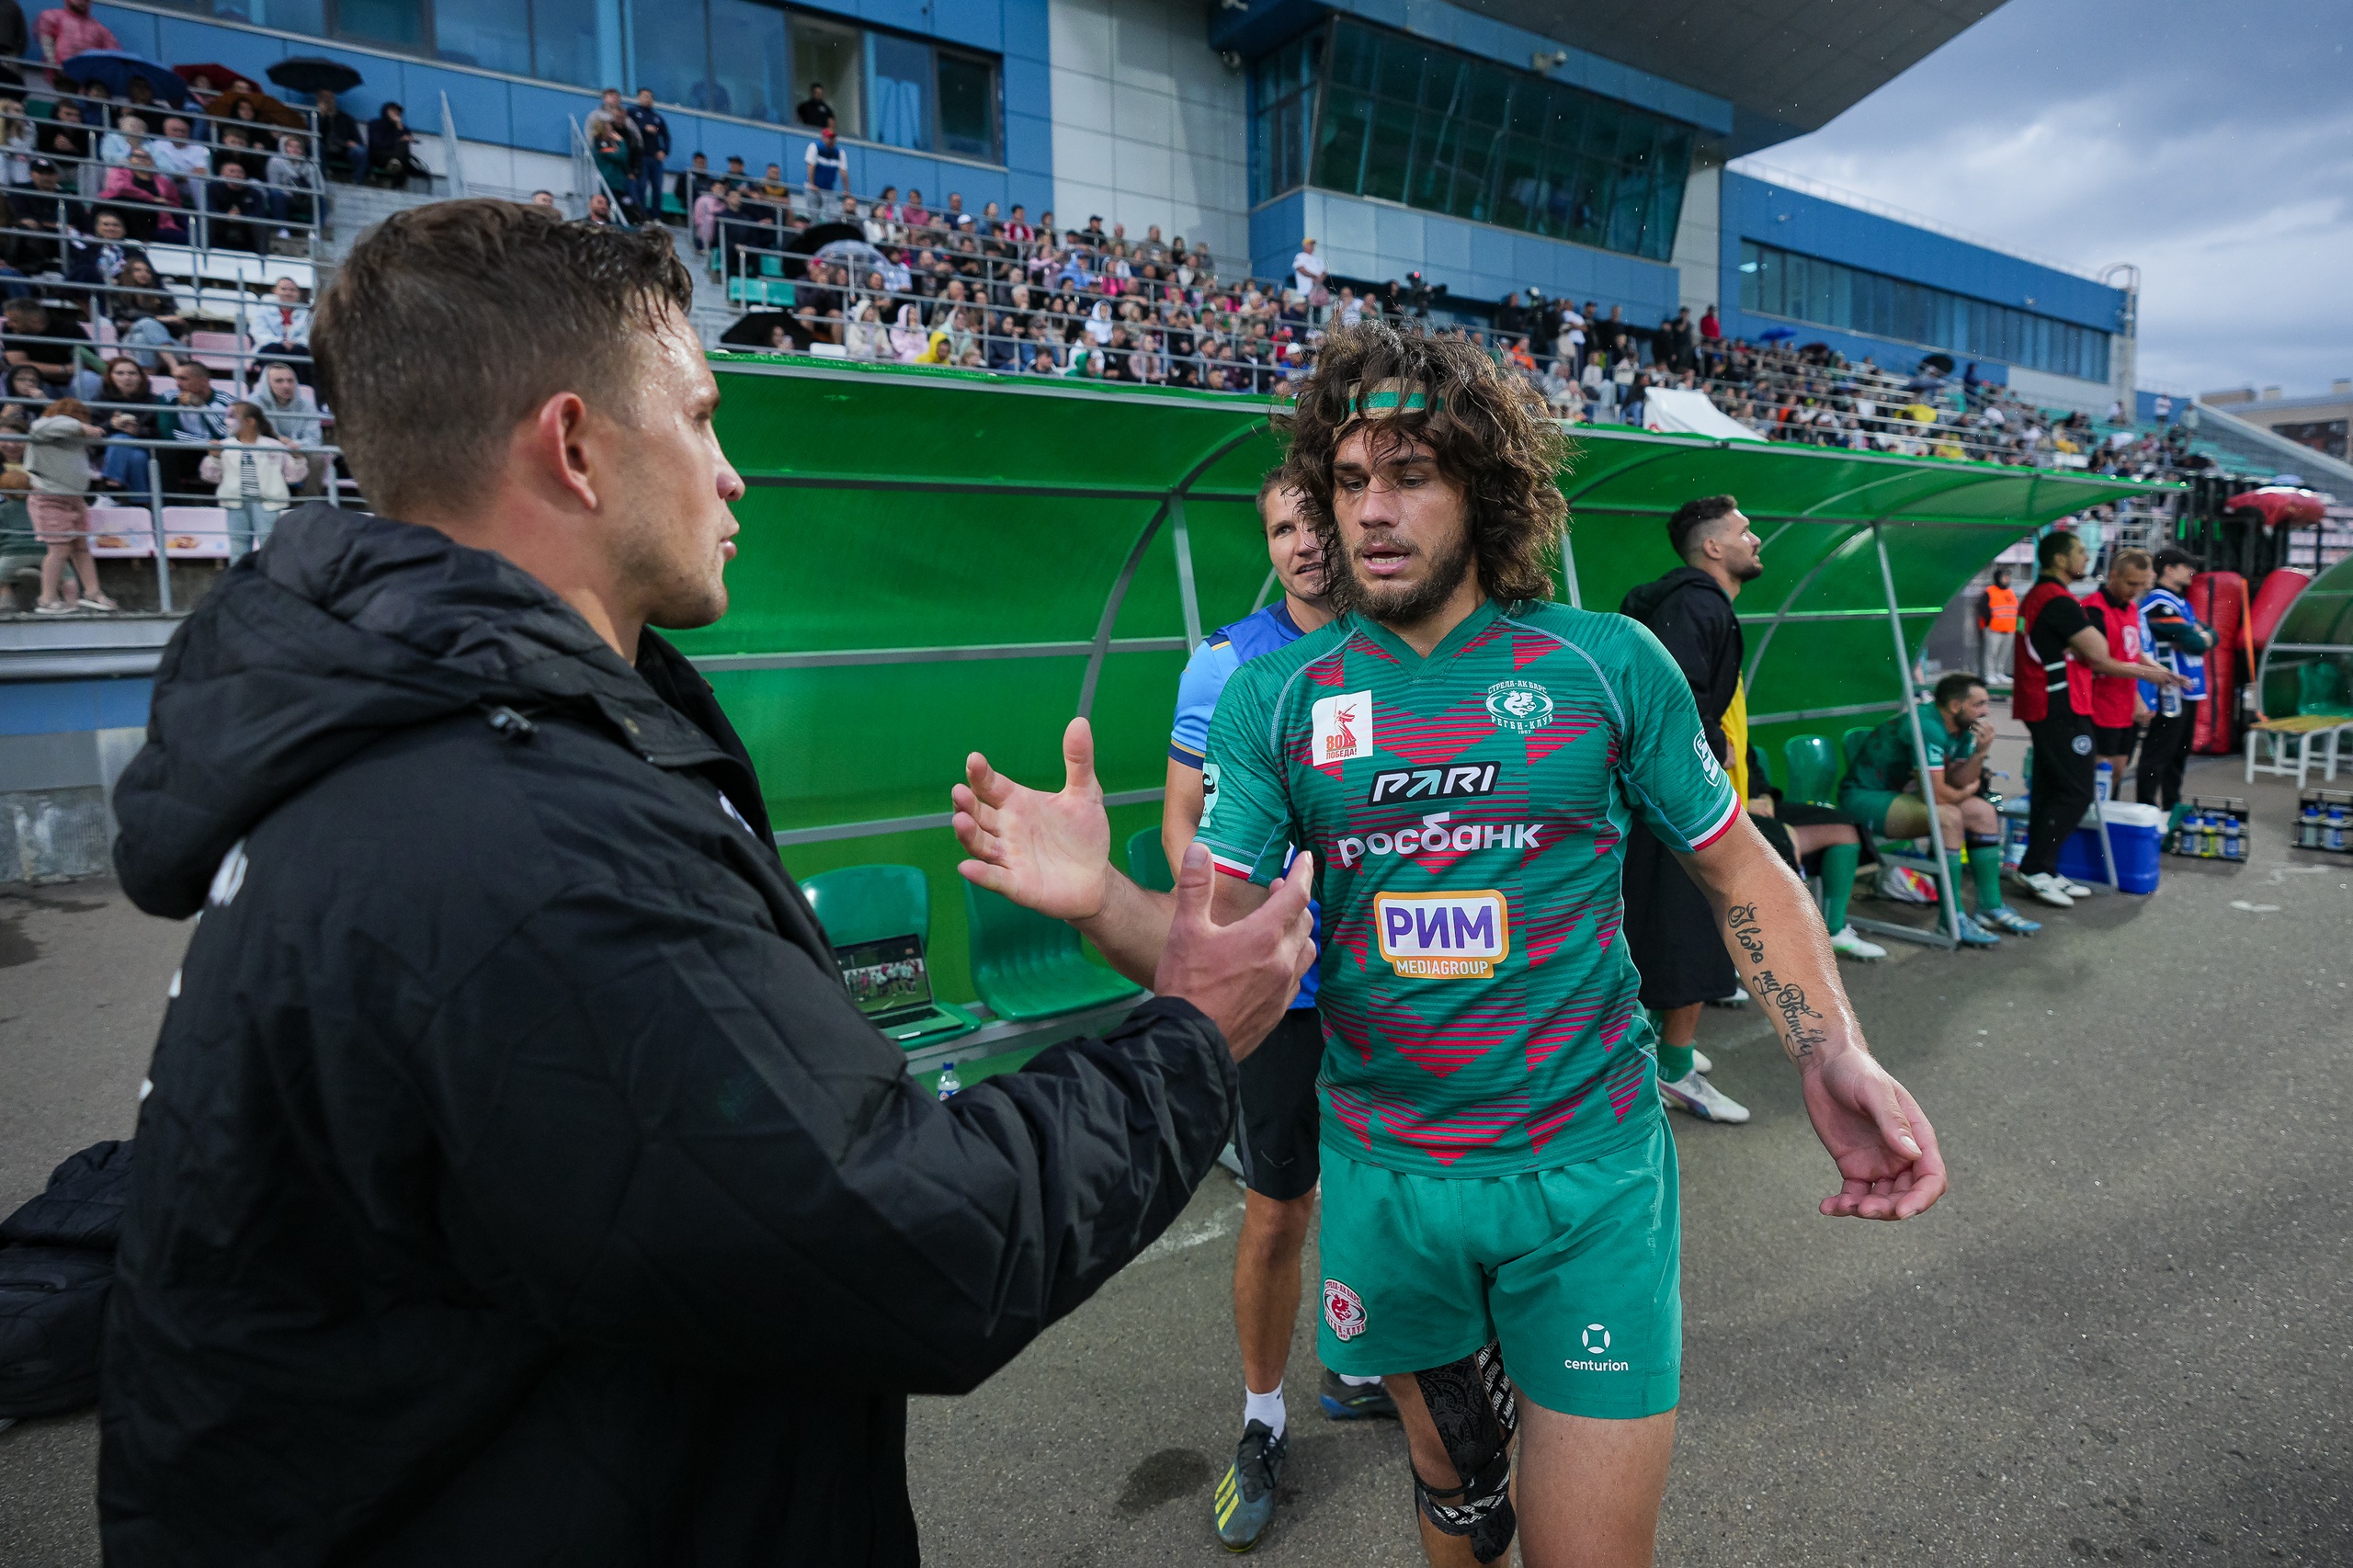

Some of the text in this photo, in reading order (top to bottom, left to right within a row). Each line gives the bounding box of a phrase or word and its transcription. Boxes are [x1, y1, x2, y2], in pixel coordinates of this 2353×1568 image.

[1326, 734, 1343, 751] 80
[1326, 748, 1358, 759] ПОБЕДА!
[1372, 765, 1495, 802] PARI
[1337, 812, 1545, 868] росбанк
[1385, 905, 1495, 949] РИМ
[1396, 960, 1489, 975] MEDIAGROUP
[1564, 1359, 1629, 1371] centurion
